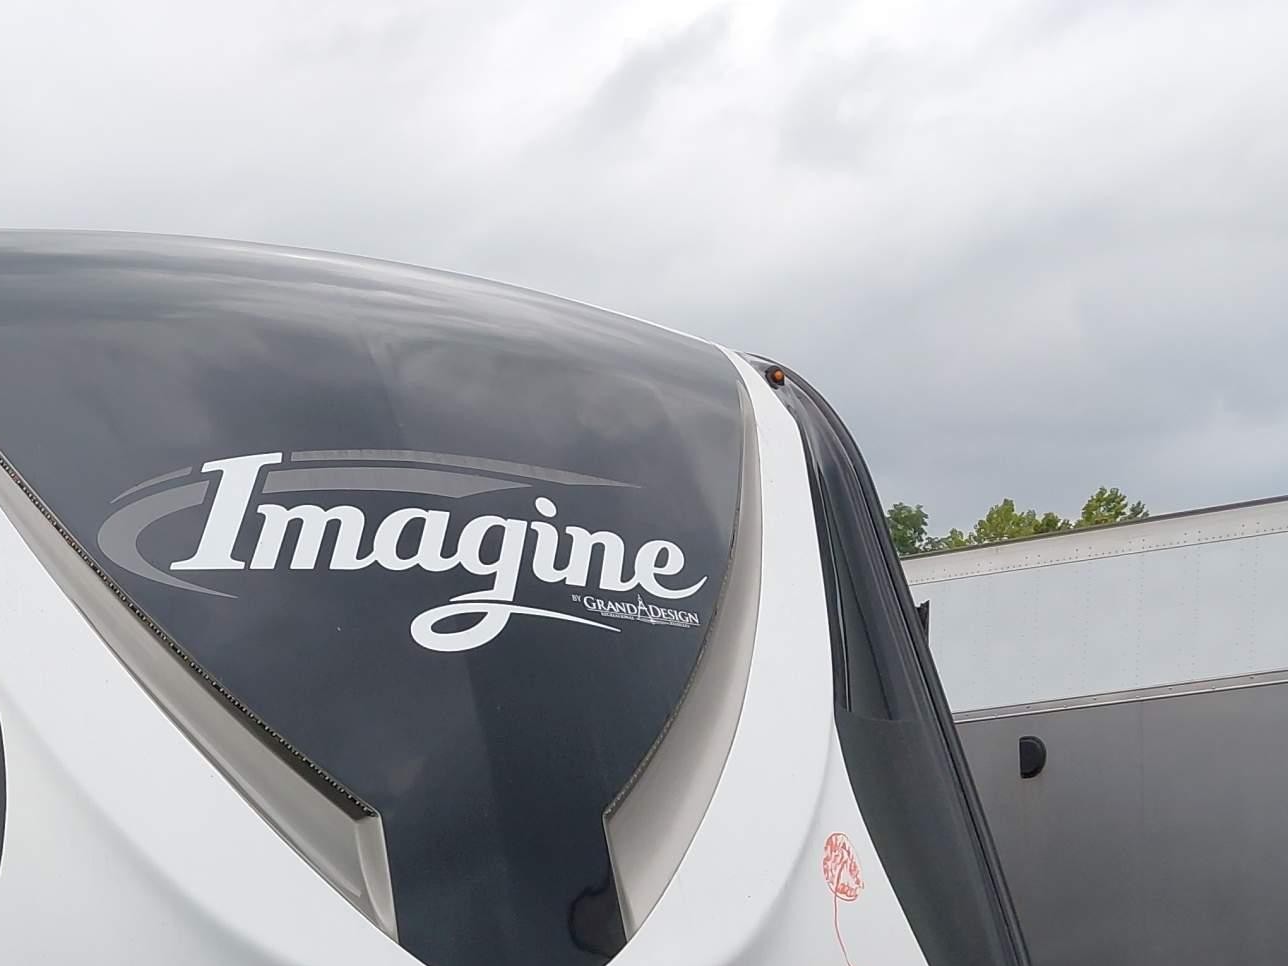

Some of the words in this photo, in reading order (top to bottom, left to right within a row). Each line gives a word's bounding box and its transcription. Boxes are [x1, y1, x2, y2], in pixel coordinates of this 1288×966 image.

[169, 452, 709, 653] Imagine
[571, 594, 582, 603] BY
[583, 595, 638, 615] GRAND
[647, 604, 701, 625] DESIGN
